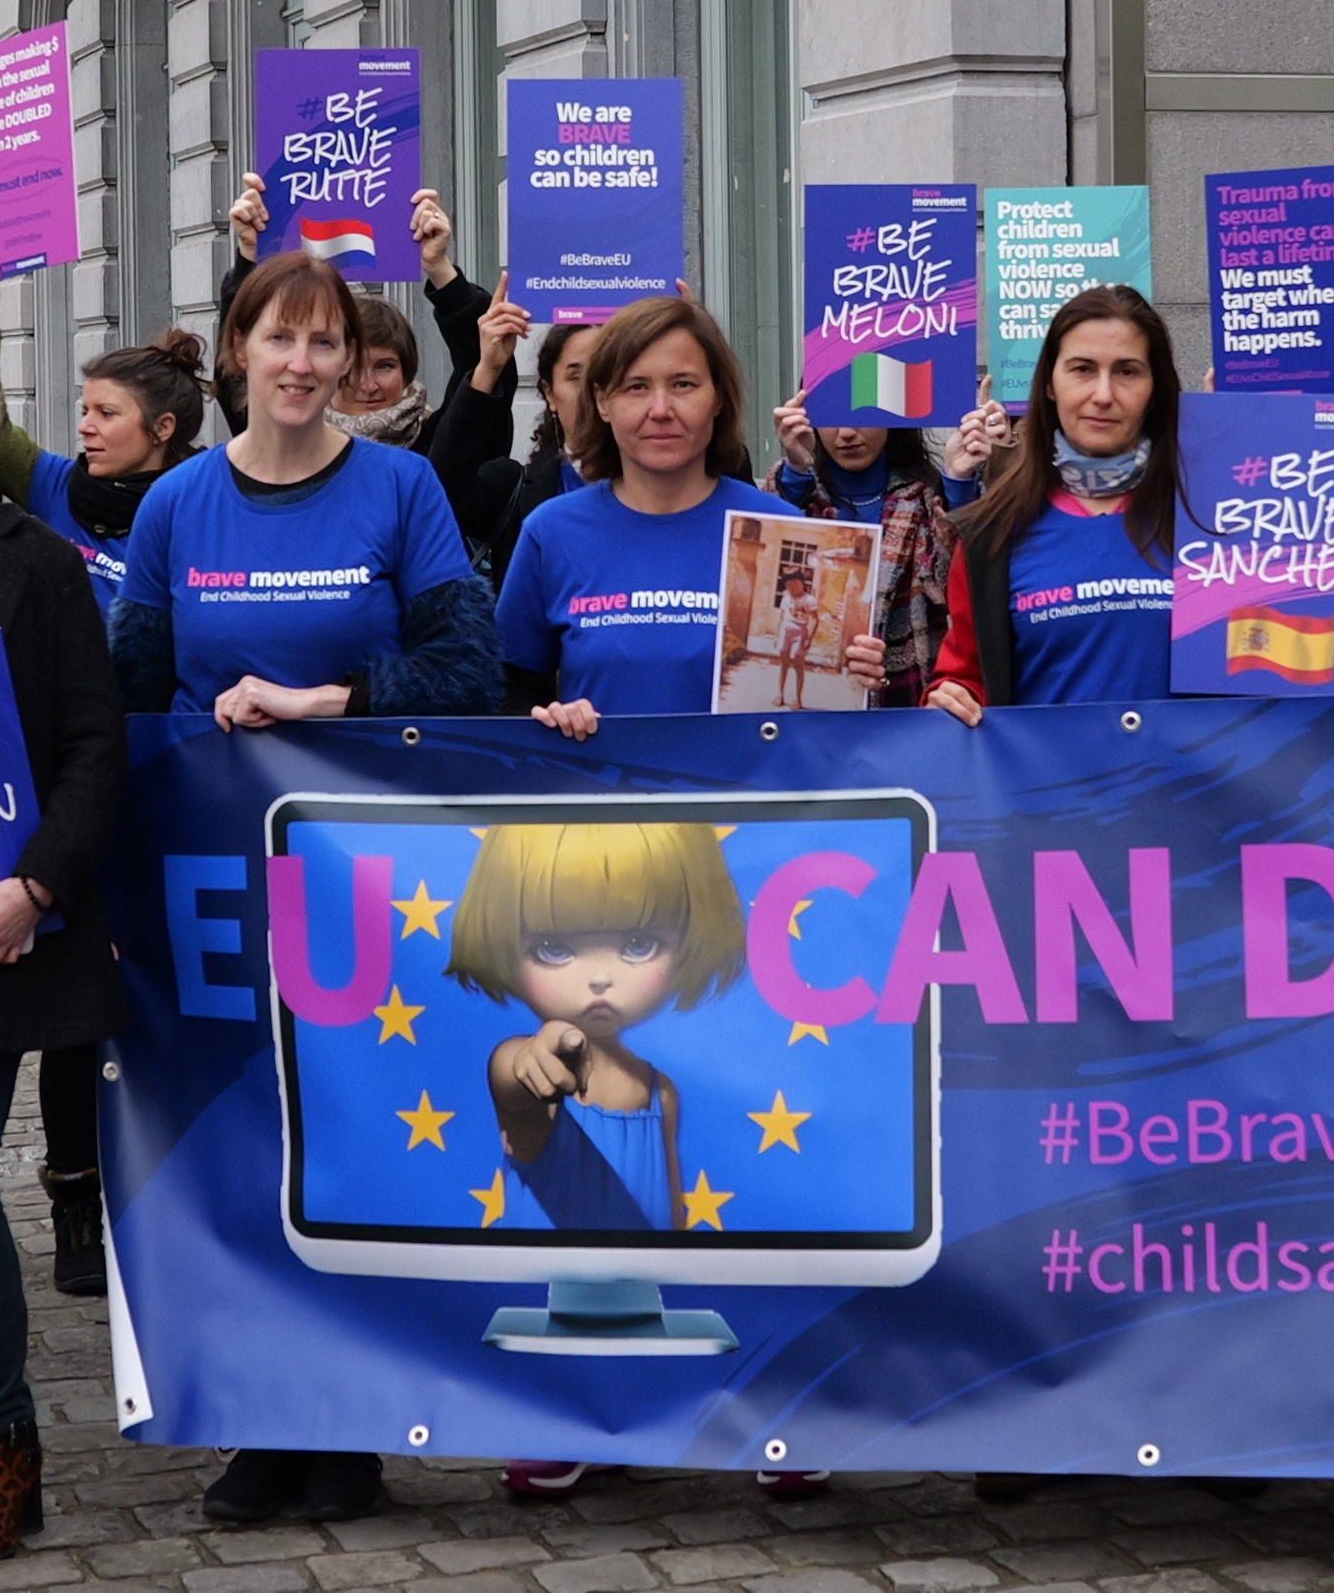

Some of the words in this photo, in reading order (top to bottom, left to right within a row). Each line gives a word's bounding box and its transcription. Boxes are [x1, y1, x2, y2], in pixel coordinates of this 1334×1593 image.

[15, 41, 52, 63] making
[2, 70, 20, 88] the
[19, 60, 51, 82] sexual
[358, 60, 411, 71] movement
[5, 91, 16, 108] of
[15, 82, 55, 105] children
[5, 103, 52, 129] DOUBLED
[556, 102, 593, 123] We
[595, 106, 632, 123] are
[11, 130, 41, 151] years.
[558, 124, 631, 144] BRAVE
[284, 127, 397, 168] BRAVE
[534, 149, 560, 166] so
[563, 144, 655, 166] children
[280, 167, 392, 208] RUTTE
[530, 170, 570, 188] can
[573, 167, 602, 188] be
[604, 166, 659, 188] safe!
[912, 197, 967, 206] movement
[1217, 184, 1299, 205] Trauma
[997, 200, 1074, 220] Protect
[1218, 202, 1287, 226] sexual
[846, 218, 937, 260] #BE
[997, 219, 1083, 239] children
[1218, 225, 1306, 247] violence
[997, 239, 1049, 259] from
[1052, 238, 1121, 258] sexual
[1220, 247, 1260, 268] last
[1261, 249, 1276, 266] a
[560, 254, 631, 266] #BeBraveEU
[998, 260, 1085, 279] violence
[525, 276, 666, 290] #Endchildsexualviolence
[833, 259, 952, 302] BRAVE
[1219, 268, 1255, 289] We
[1256, 264, 1313, 287] must
[999, 280, 1052, 300] NOW
[1055, 284, 1080, 299] so
[1221, 287, 1288, 313] target
[558, 309, 583, 319] brave
[821, 301, 958, 344] MELONI
[999, 304, 1036, 319] can
[1222, 310, 1259, 331] the
[1261, 307, 1321, 329] harm
[1223, 330, 1323, 356] happens.
[187, 566, 247, 588] brave
[249, 564, 371, 588] movement
[200, 591, 219, 603] End
[219, 589, 271, 603] Childhood
[272, 590, 306, 602] Sexual
[307, 589, 351, 601] Violence
[1016, 586, 1074, 612] brave
[580, 616, 601, 629] End
[601, 611, 654, 627] Childhood
[655, 612, 691, 624] Sexual
[1029, 611, 1049, 625] End
[1048, 601, 1102, 620] Childhood
[1102, 598, 1137, 612] Sexual
[743, 847, 1174, 1026] CAN
